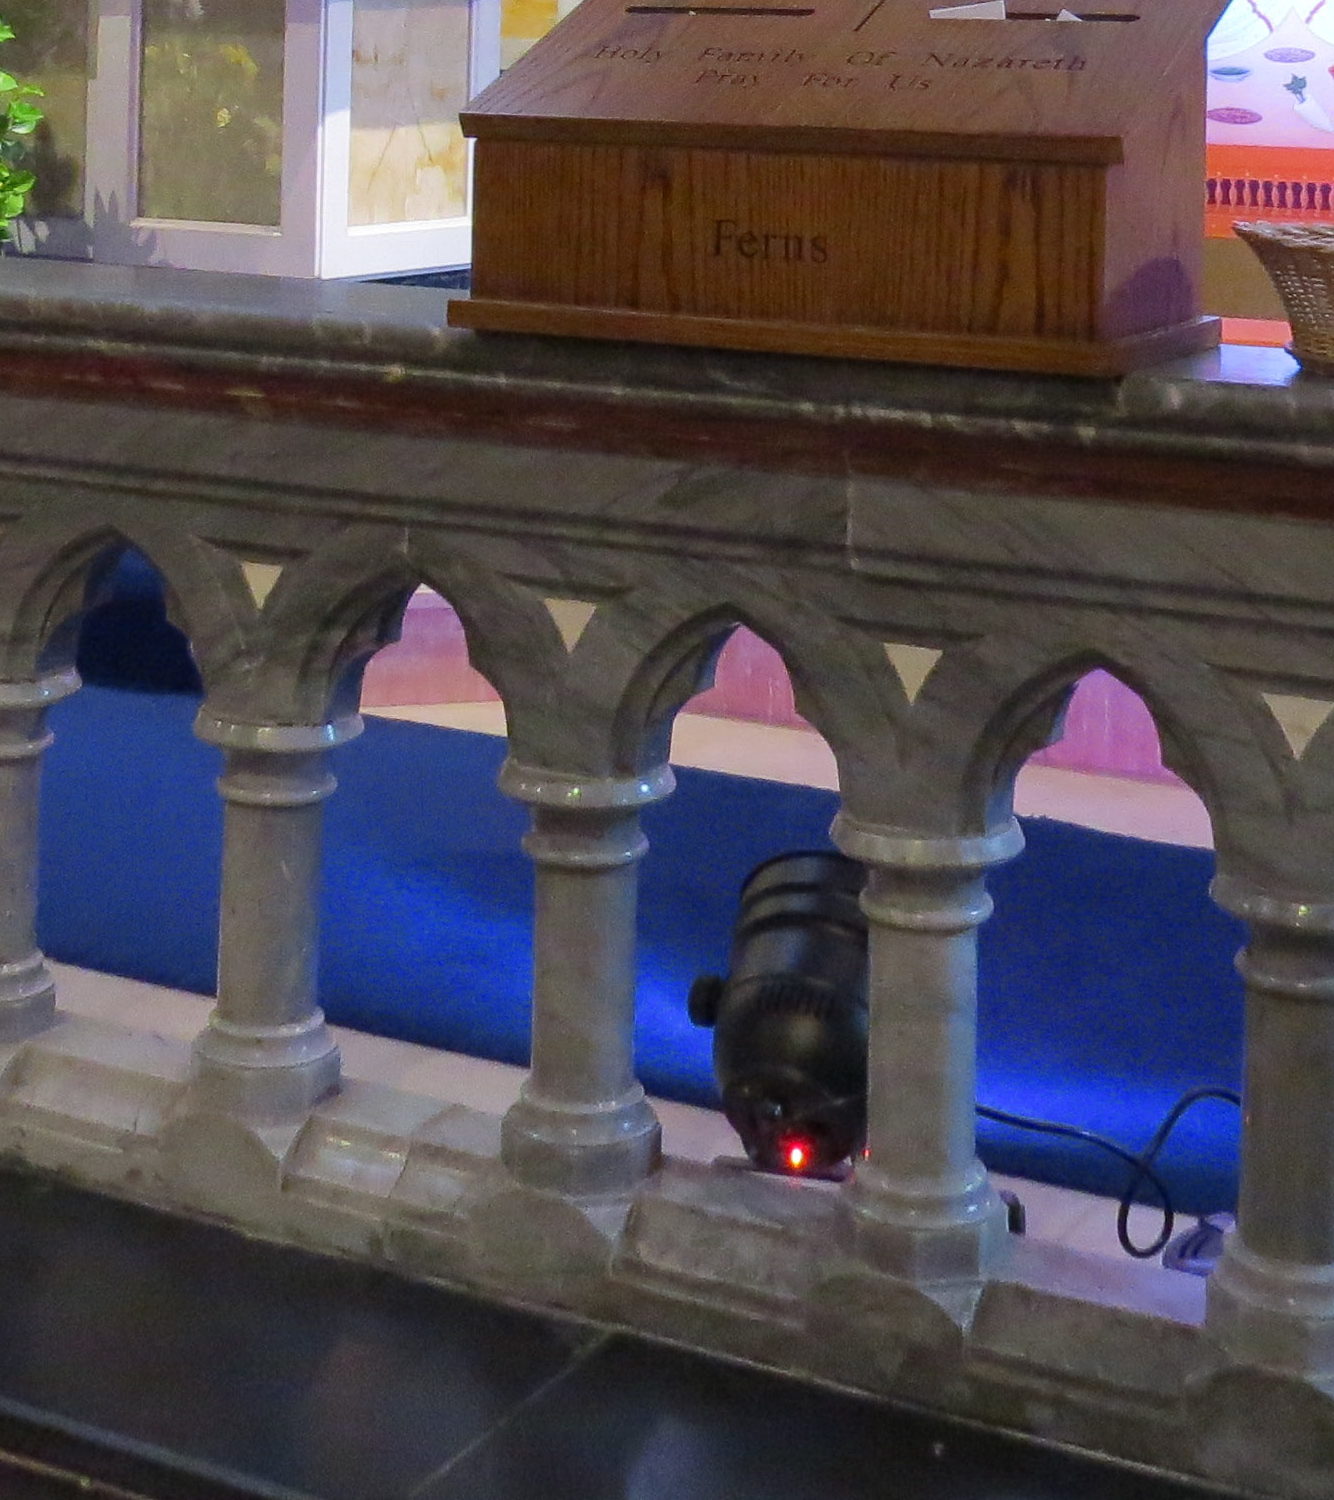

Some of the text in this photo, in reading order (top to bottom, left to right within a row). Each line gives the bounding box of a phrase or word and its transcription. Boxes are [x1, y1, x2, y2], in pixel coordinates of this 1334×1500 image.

[593, 45, 1087, 72] Holy Family Of Nazareth
[694, 69, 931, 91] Pray For Us
[711, 218, 828, 264] Ferns
